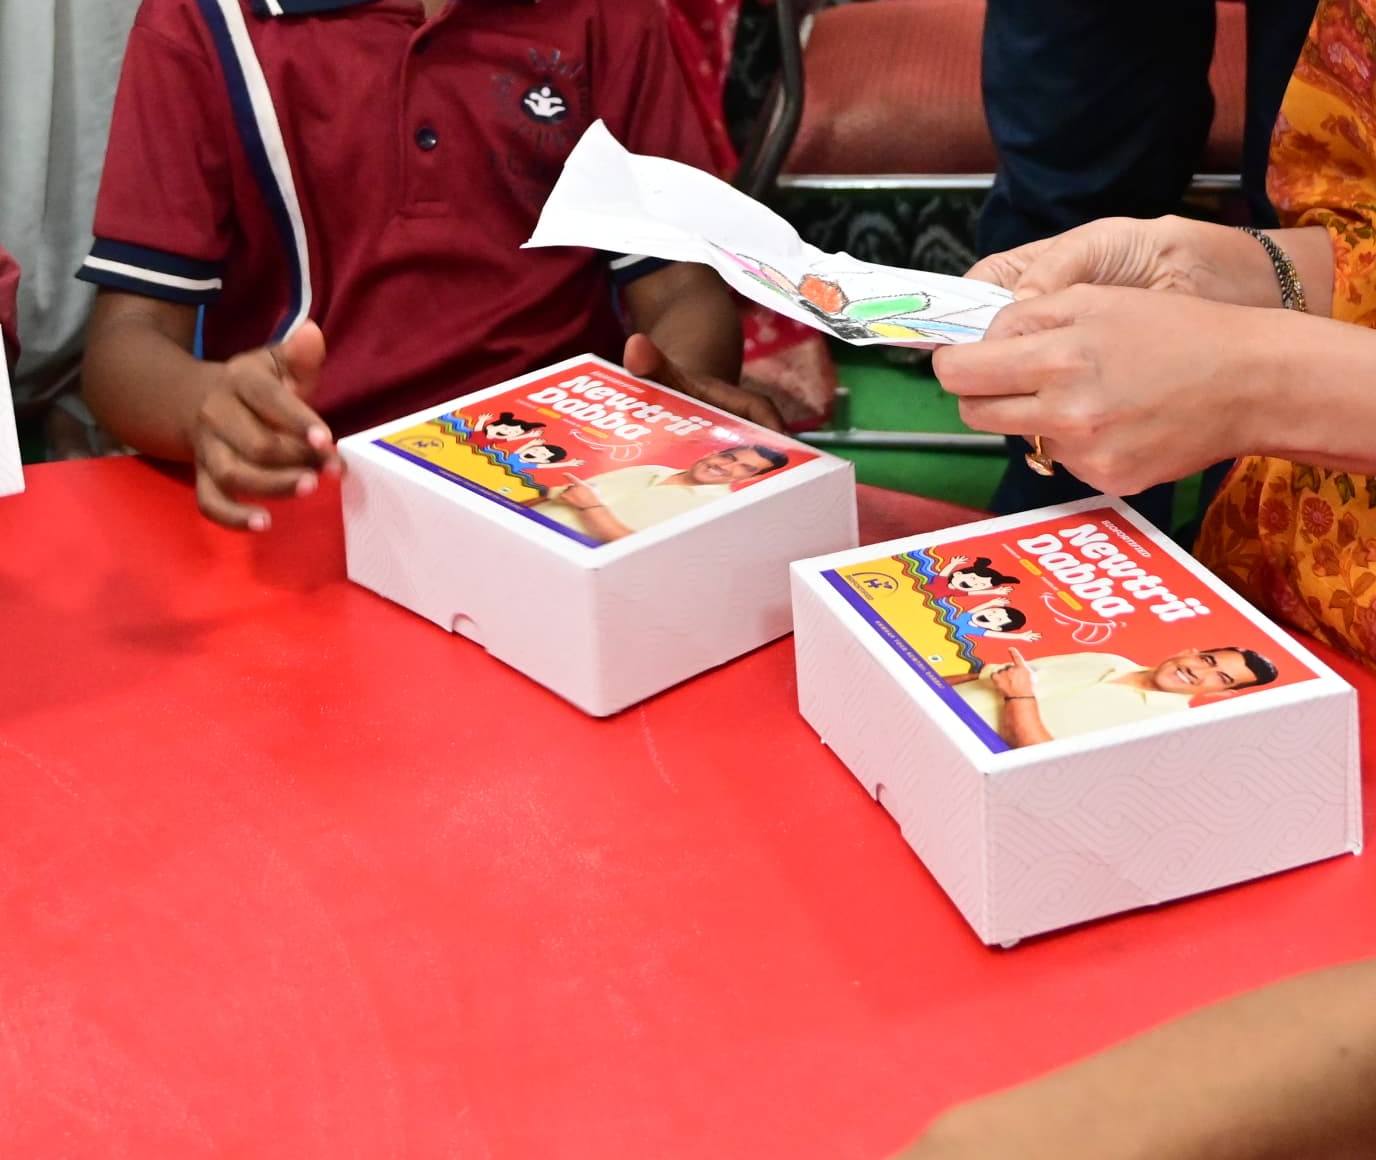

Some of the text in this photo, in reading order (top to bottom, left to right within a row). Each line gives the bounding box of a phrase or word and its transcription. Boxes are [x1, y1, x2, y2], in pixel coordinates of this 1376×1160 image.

[527, 386, 652, 440] Dabba
[558, 375, 712, 436] Newtrii
[1101, 520, 1151, 558] BIOFORTIFIED
[1017, 533, 1135, 618] Dabba
[1058, 523, 1211, 622] Newtrii
